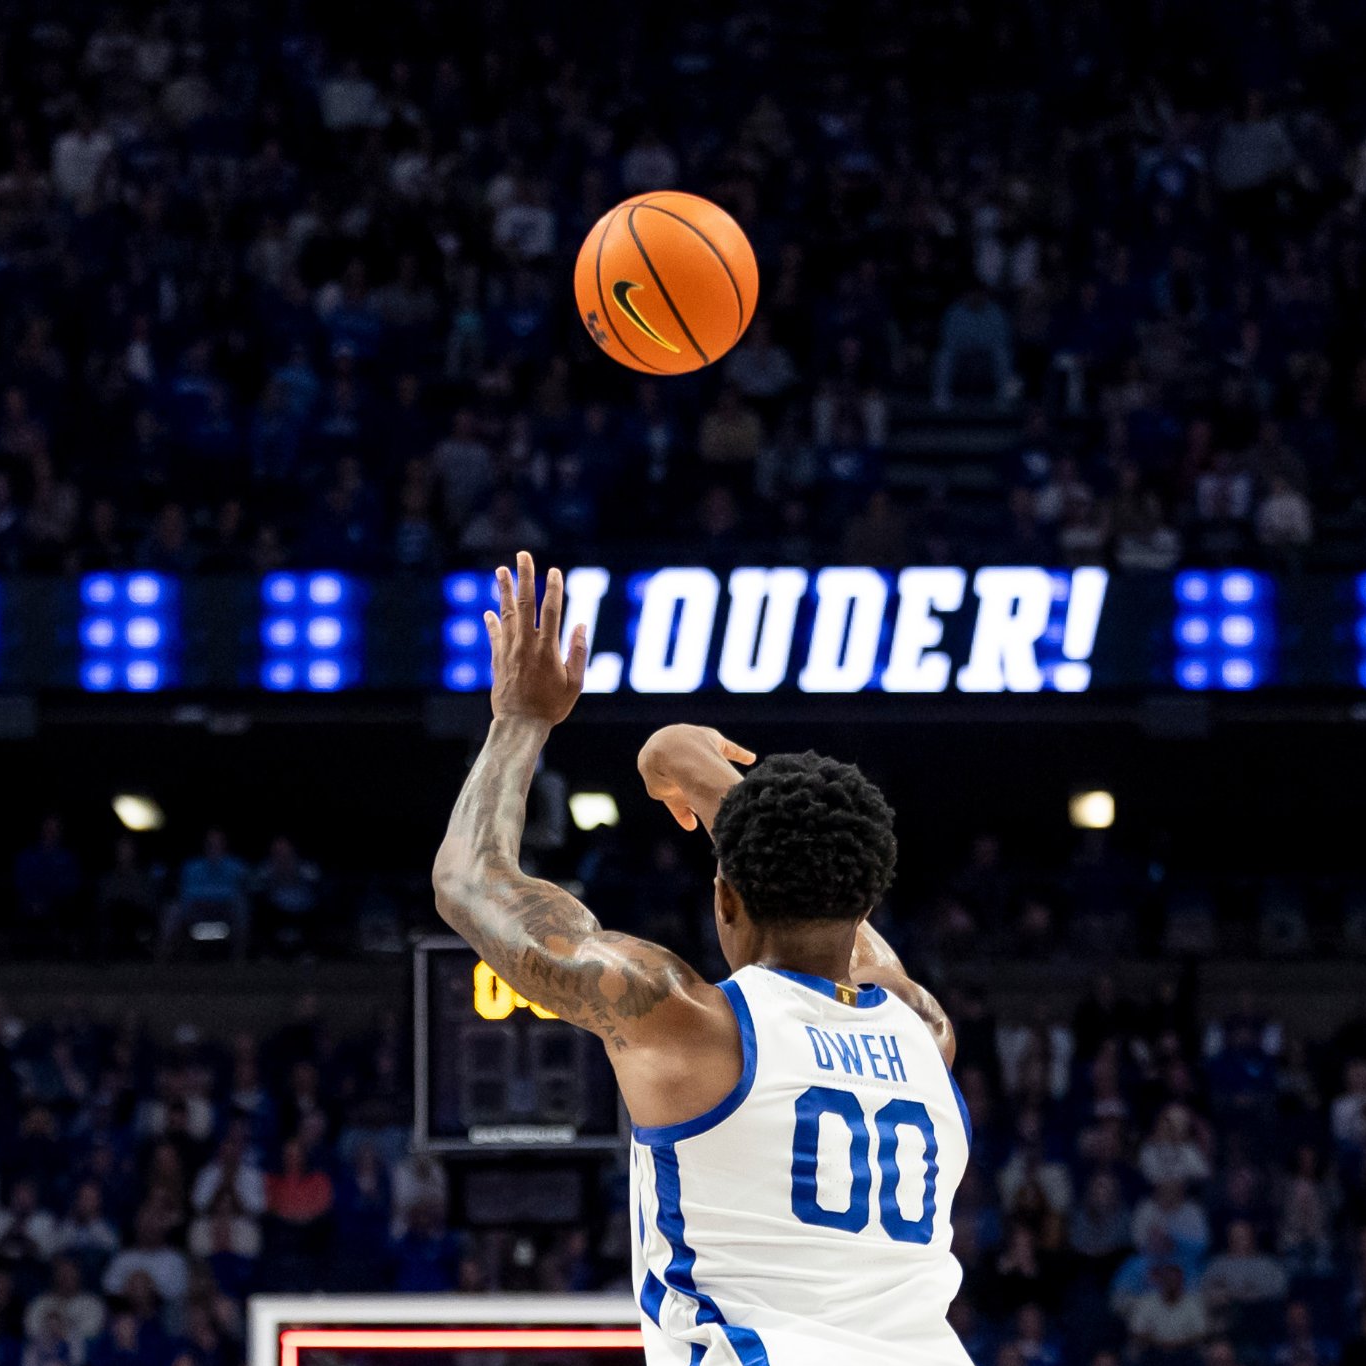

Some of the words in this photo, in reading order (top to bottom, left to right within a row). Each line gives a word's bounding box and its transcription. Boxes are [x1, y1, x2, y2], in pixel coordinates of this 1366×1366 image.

[562, 566, 1108, 693] LOUDER!
[805, 1025, 908, 1083] OWEH
[791, 1085, 939, 1245] 00
